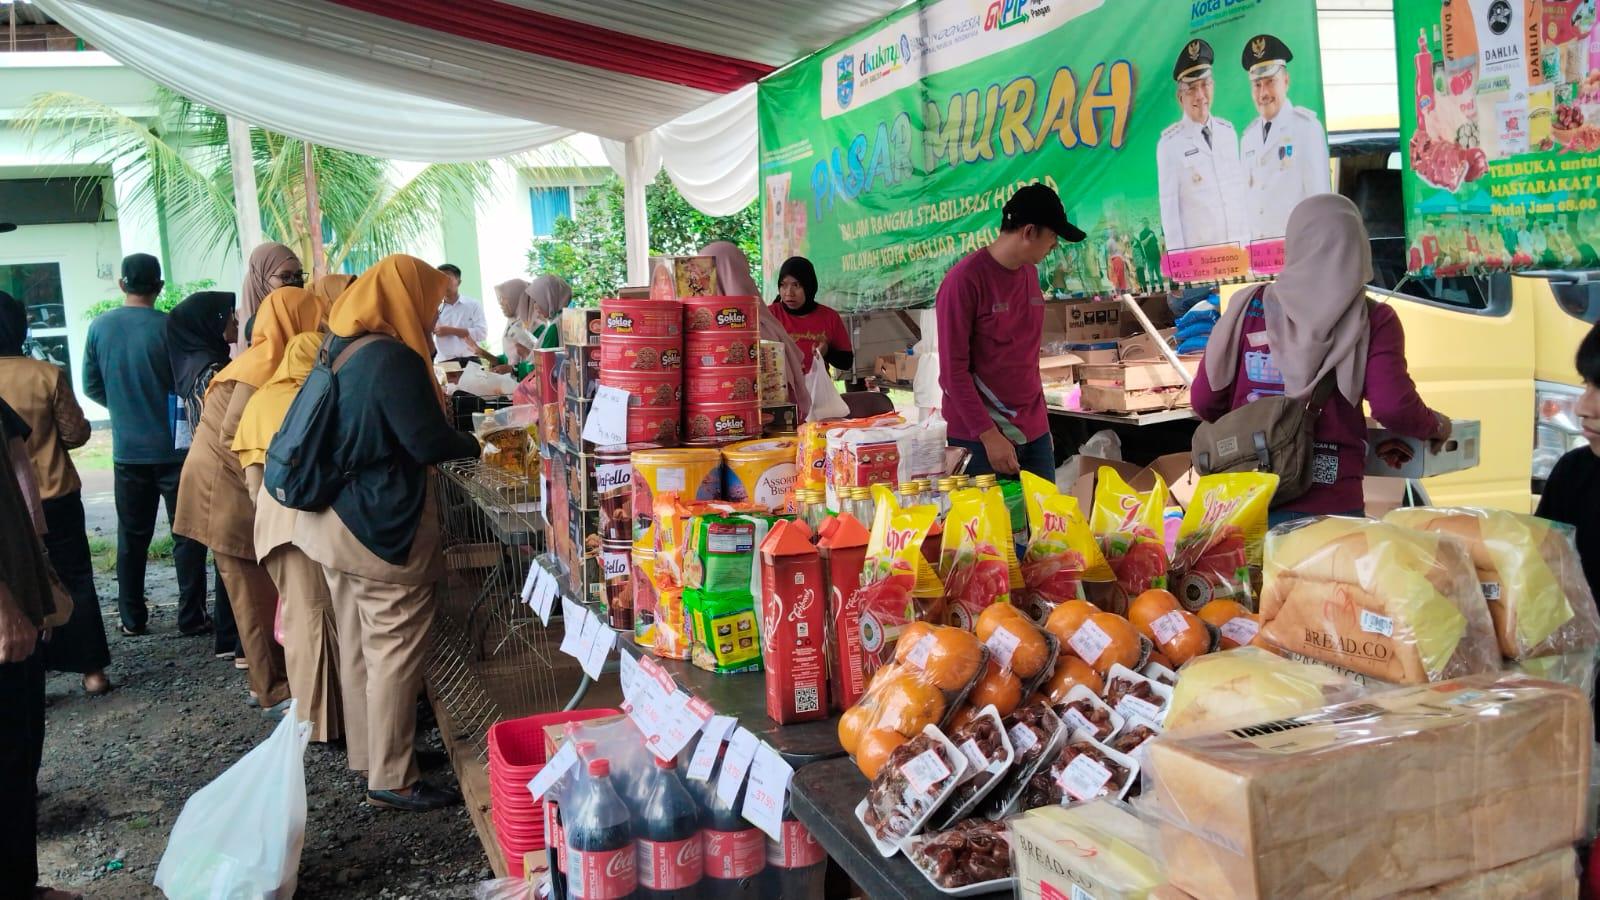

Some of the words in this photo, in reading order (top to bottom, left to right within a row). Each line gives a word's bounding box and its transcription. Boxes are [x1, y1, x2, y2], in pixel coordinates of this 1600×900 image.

[1031, 5, 1051, 18] Pangan
[1192, 0, 1221, 20] Kota
[1484, 44, 1519, 61] DAHLIA
[1529, 23, 1540, 78] DAHLIA
[810, 111, 913, 223] PASAR
[921, 58, 1134, 174] MURAH
[1490, 160, 1556, 178] TERBUKA
[1491, 175, 1592, 197] MASYARAKAT
[871, 208, 914, 236] RANGKA
[916, 190, 991, 227] STABILISASI
[1491, 202, 1526, 217] Mulai
[1528, 199, 1556, 214] Jam
[841, 248, 879, 273] WILAYAH
[880, 244, 907, 266] KOTA
[908, 235, 956, 262] BANJAR
[1213, 266, 1240, 276] Banjar
[607, 317, 632, 329] Soklat
[717, 313, 745, 325] Soklat
[715, 419, 744, 431] Soklat
[1304, 627, 1388, 659] BREAD.CO
